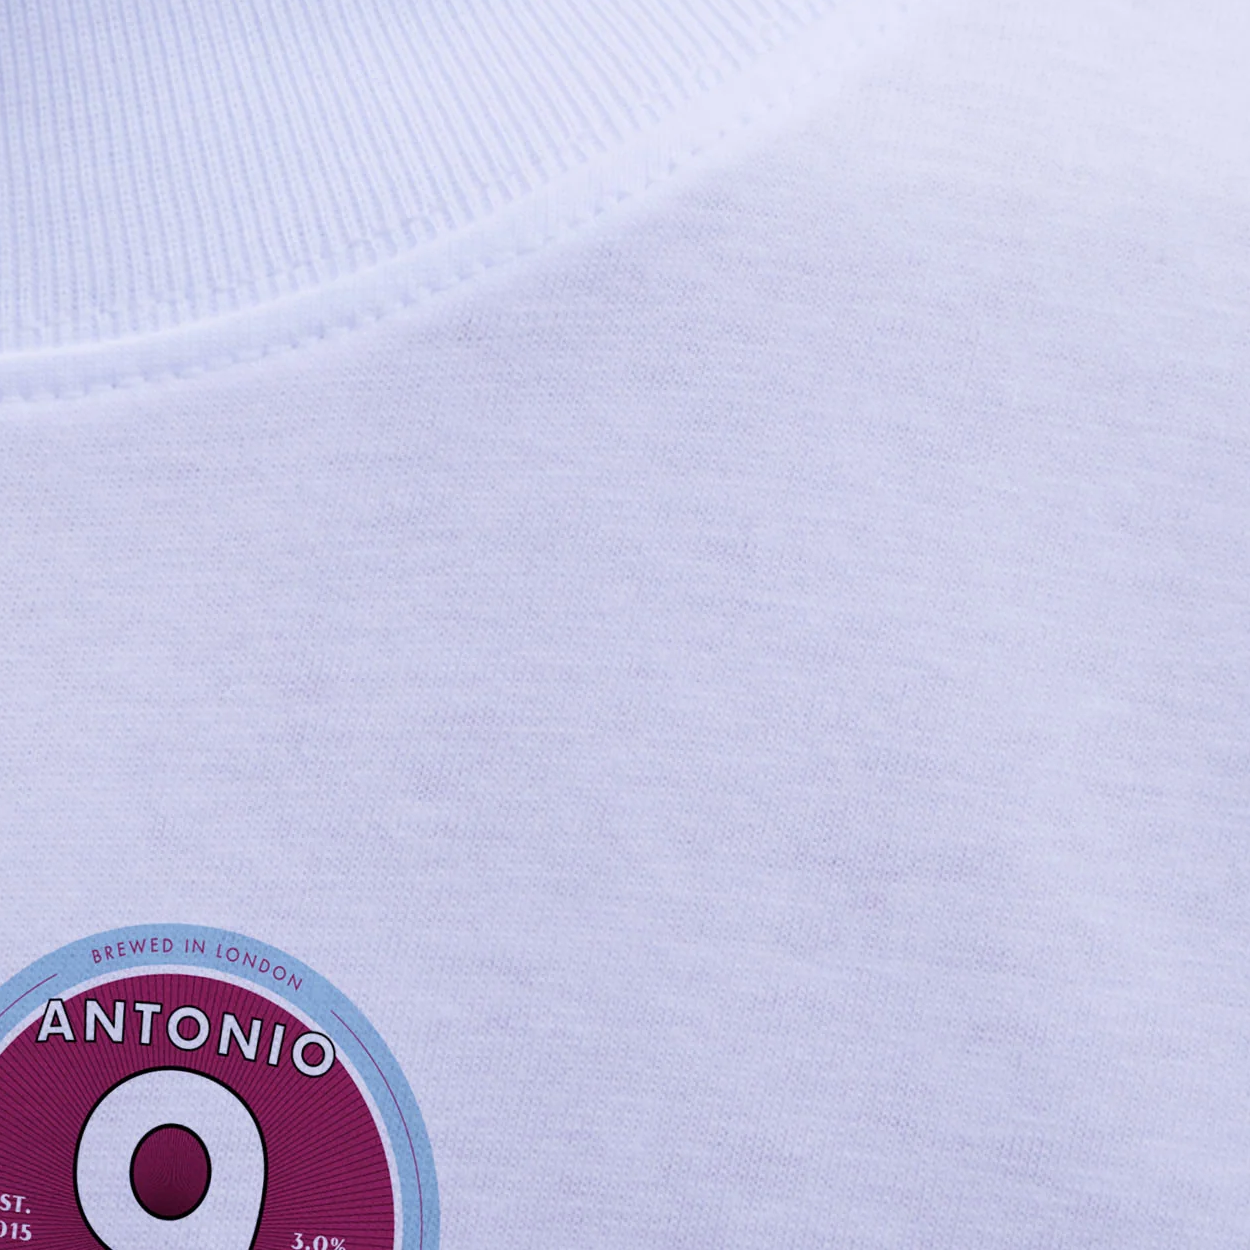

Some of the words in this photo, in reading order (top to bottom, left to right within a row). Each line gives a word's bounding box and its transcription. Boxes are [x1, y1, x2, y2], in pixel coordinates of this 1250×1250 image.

[91, 937, 174, 964] BREWED
[185, 939, 206, 954] IN
[216, 943, 303, 991] LONDON
[36, 998, 336, 1078] ANTONIO
[291, 1232, 346, 1250] 3.0%
